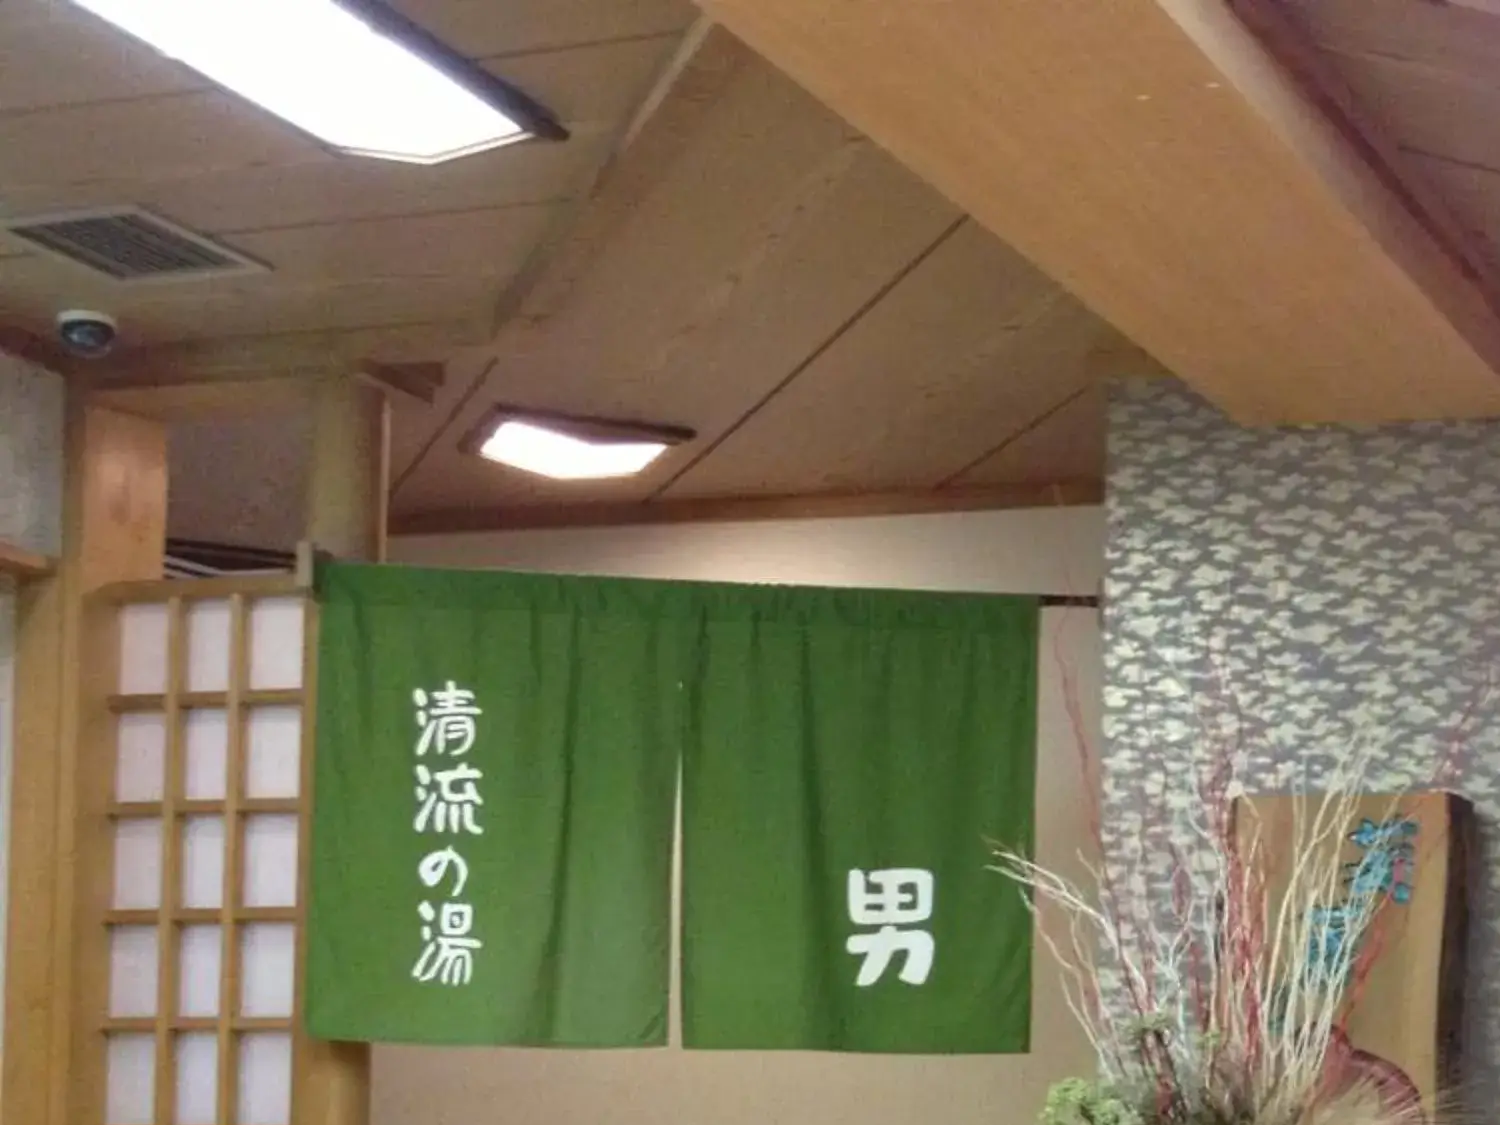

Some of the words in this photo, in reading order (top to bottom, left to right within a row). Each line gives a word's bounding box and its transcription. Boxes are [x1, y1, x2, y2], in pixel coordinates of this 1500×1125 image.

[411, 679, 484, 987] 清流の湯
[845, 866, 936, 987] 男
